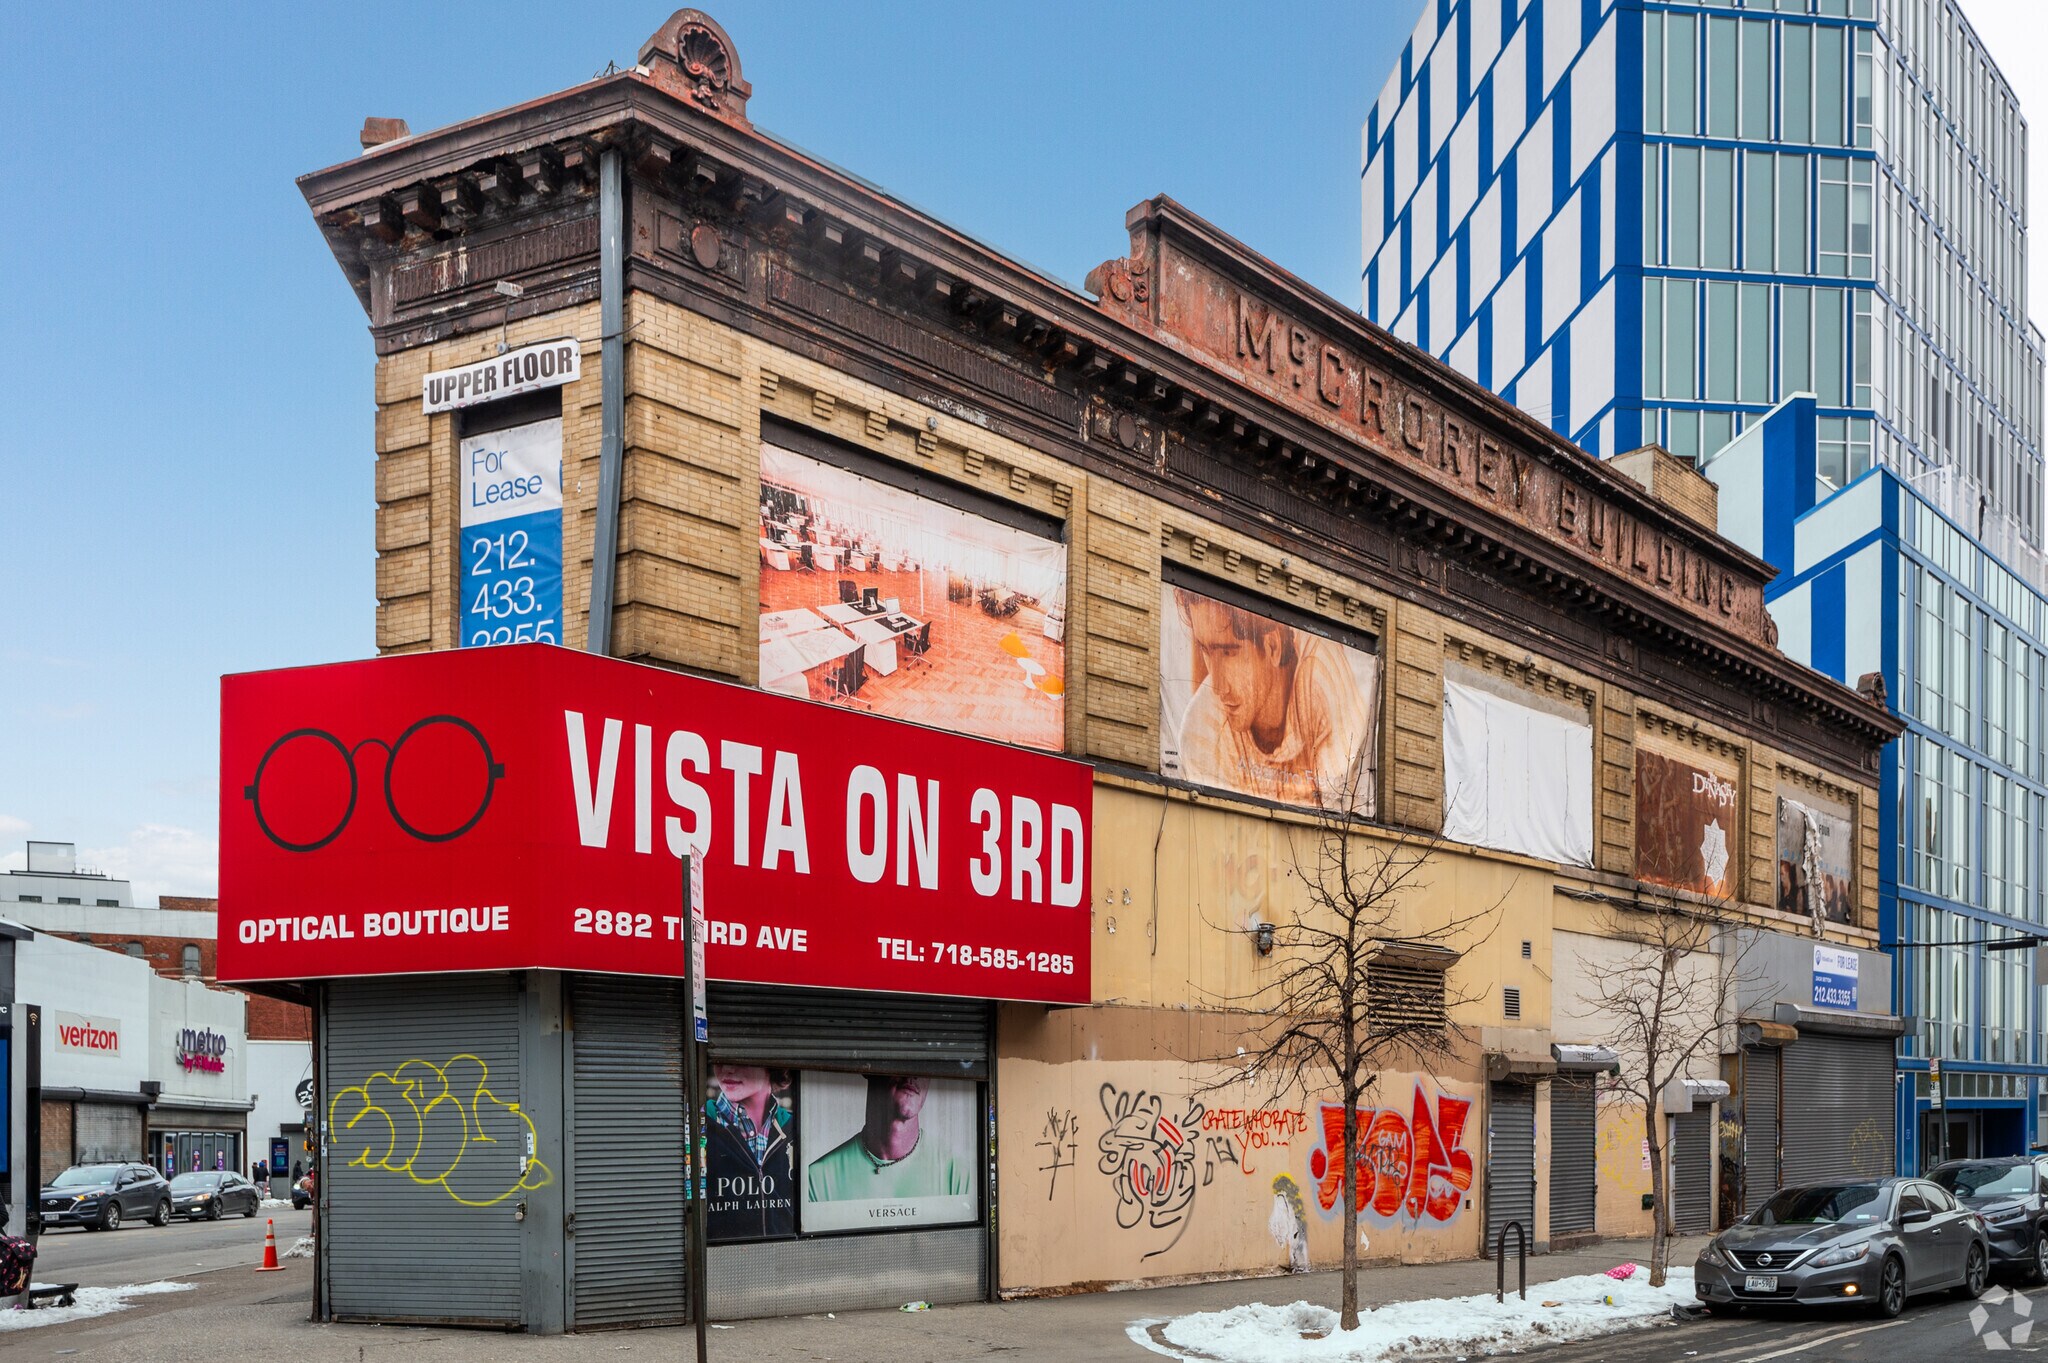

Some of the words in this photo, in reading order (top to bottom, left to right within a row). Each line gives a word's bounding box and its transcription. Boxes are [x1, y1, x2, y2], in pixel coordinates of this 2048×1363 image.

[428, 365, 497, 406] UPPER
[502, 346, 573, 388] FLOOR
[471, 448, 509, 477] For
[471, 471, 543, 508] Lease
[471, 530, 536, 577] 212.
[1559, 480, 1736, 617] BUILDING
[471, 576, 542, 621] 433.
[564, 709, 811, 875] VISTA
[846, 763, 940, 891] ON
[969, 787, 1084, 908] 3RD
[238, 914, 355, 945] OPTICAL
[363, 906, 510, 939] BOUTIQUE
[573, 907, 653, 938] 2882
[663, 915, 747, 947] TIRD
[756, 925, 808, 953] AVE
[878, 936, 925, 963] TEL:
[931, 942, 1074, 976] 718-585-1285
[1837, 954, 1845, 968] FOR
[1846, 956, 1857, 971] LEASE
[59, 1022, 118, 1050] verizon
[182, 1026, 226, 1055] metro
[717, 1175, 775, 1197] POLO
[708, 1200, 740, 1213] ALPH
[746, 1198, 792, 1211] LAUREN
[868, 1206, 918, 1218] VERSACE
